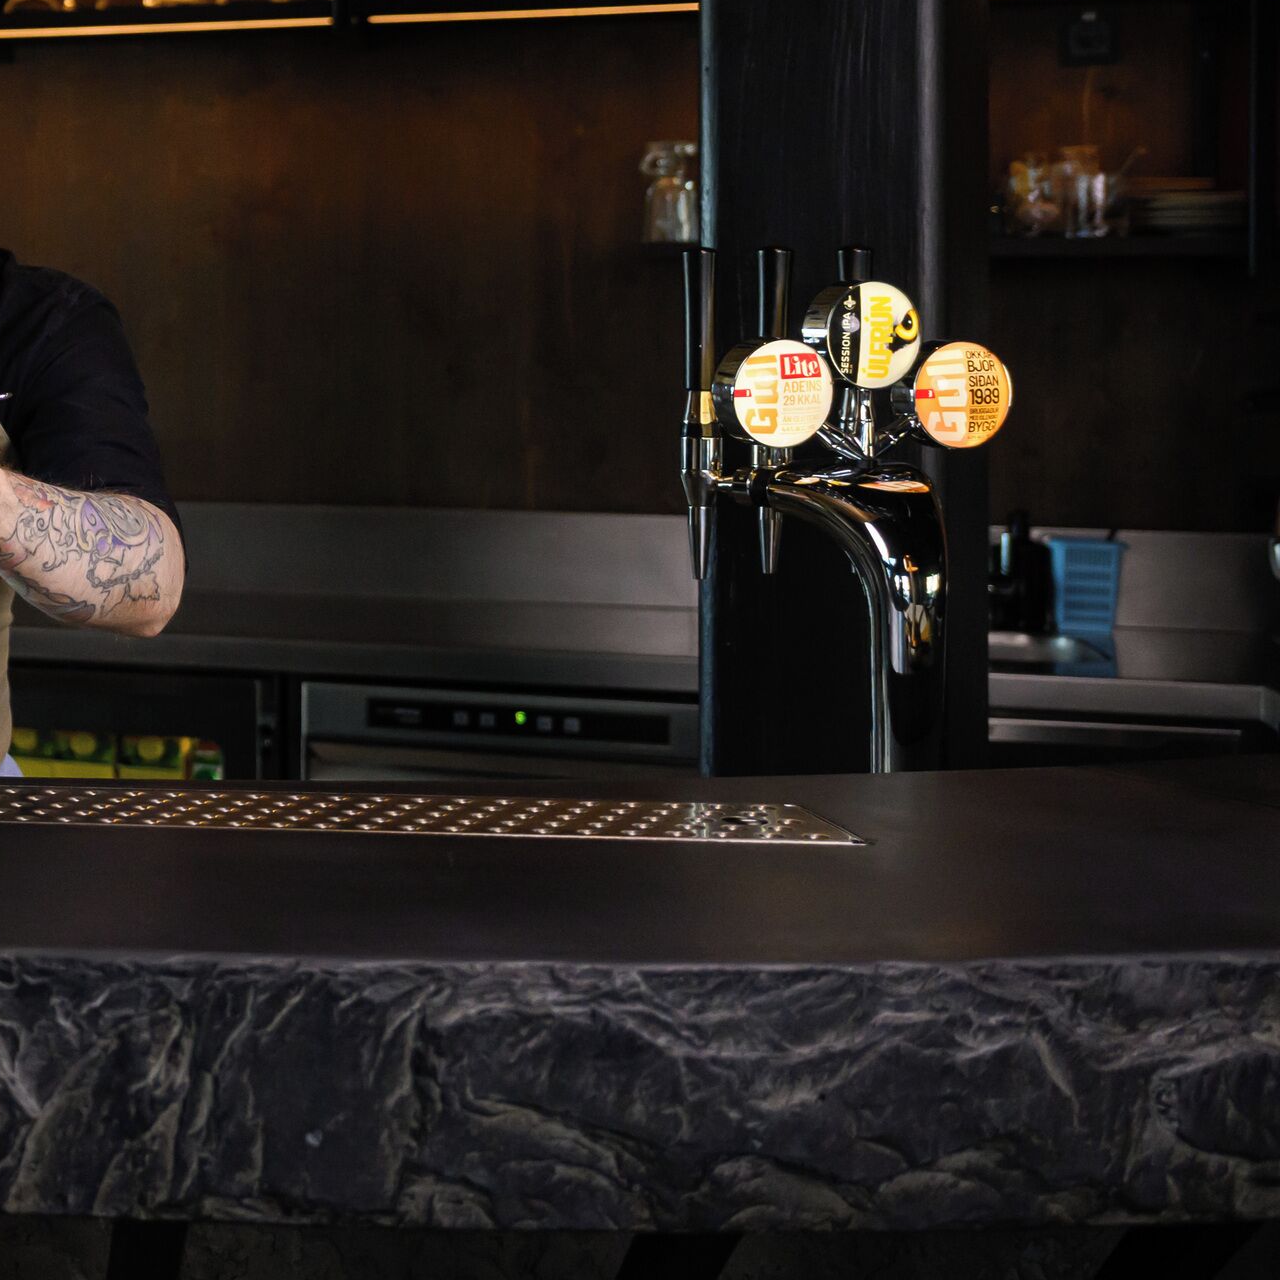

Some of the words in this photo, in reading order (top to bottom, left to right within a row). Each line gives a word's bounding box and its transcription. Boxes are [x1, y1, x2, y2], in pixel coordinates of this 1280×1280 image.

[842, 311, 852, 329] IPA
[862, 296, 894, 379] ÚLFRÚN
[841, 332, 851, 374] SESSION
[783, 355, 820, 377] Lite
[783, 395, 796, 406] 29
[797, 393, 821, 405] KKAL
[968, 388, 1000, 405] 1989
